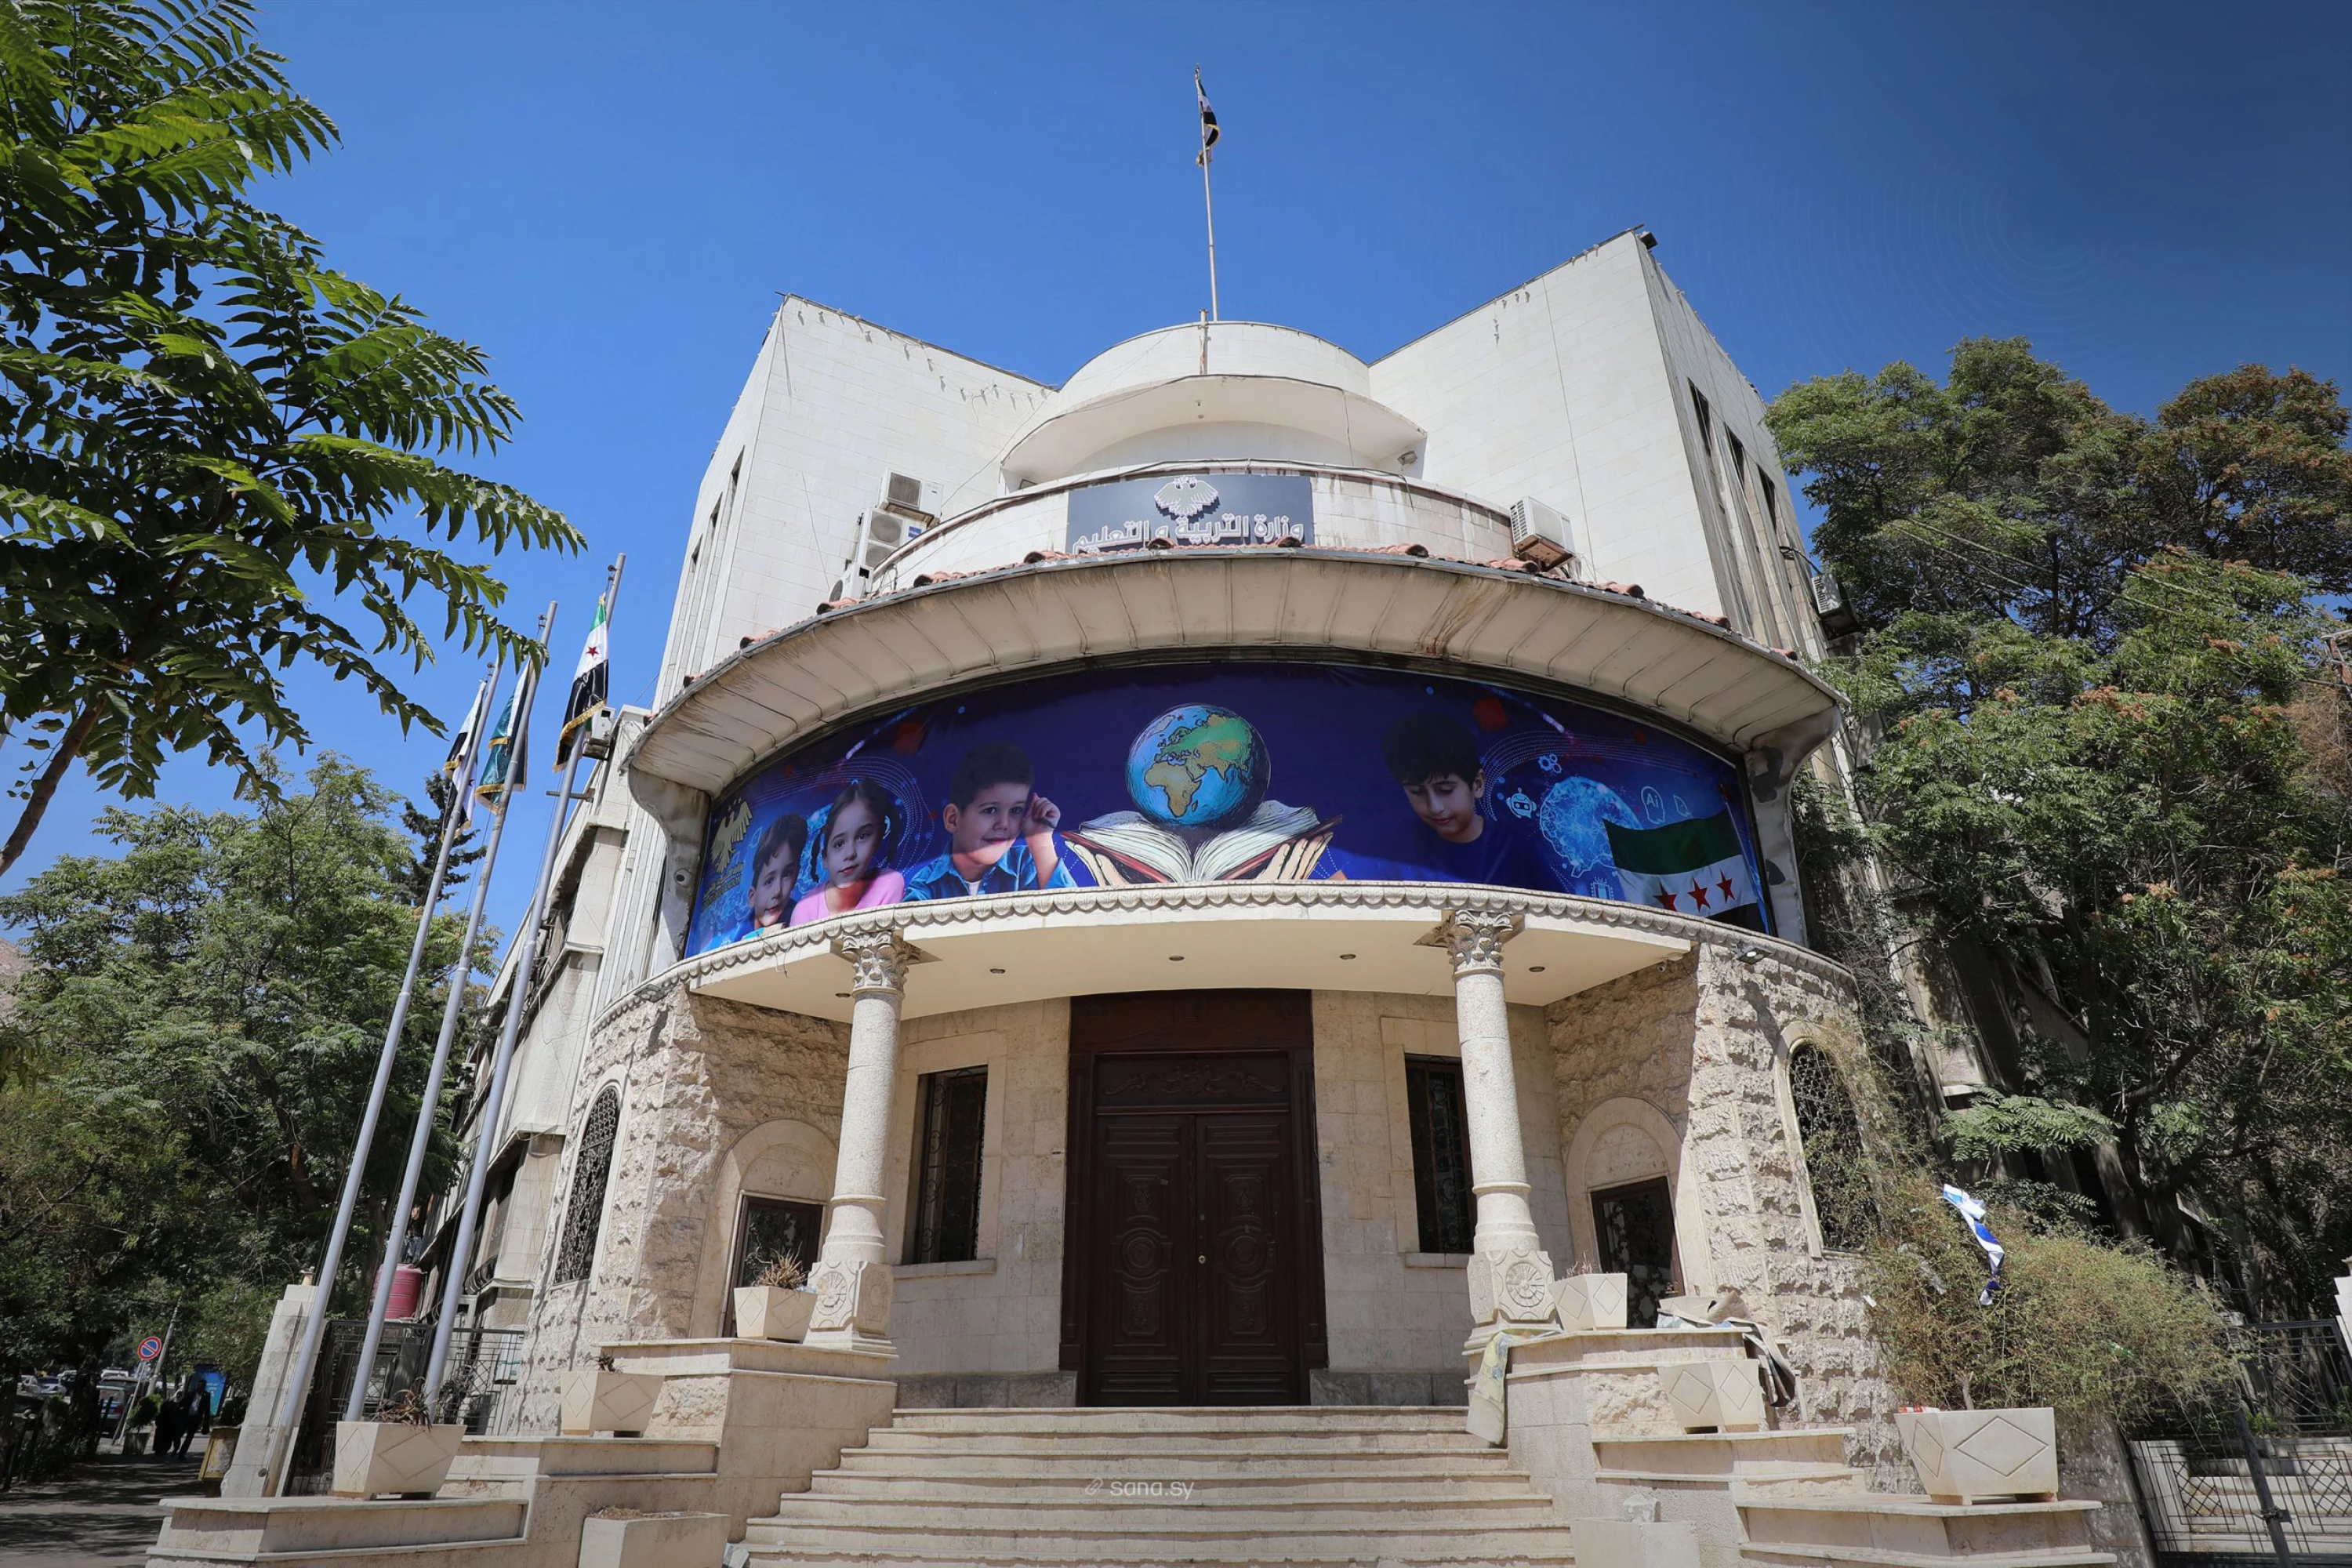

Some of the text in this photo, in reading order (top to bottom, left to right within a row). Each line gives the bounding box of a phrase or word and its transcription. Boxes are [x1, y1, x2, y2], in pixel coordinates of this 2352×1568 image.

[1073, 520, 1150, 554] التعليم
[1175, 513, 1249, 544] التربية
[1254, 514, 1304, 543] وزارة
[1646, 793, 1659, 808] Ai
